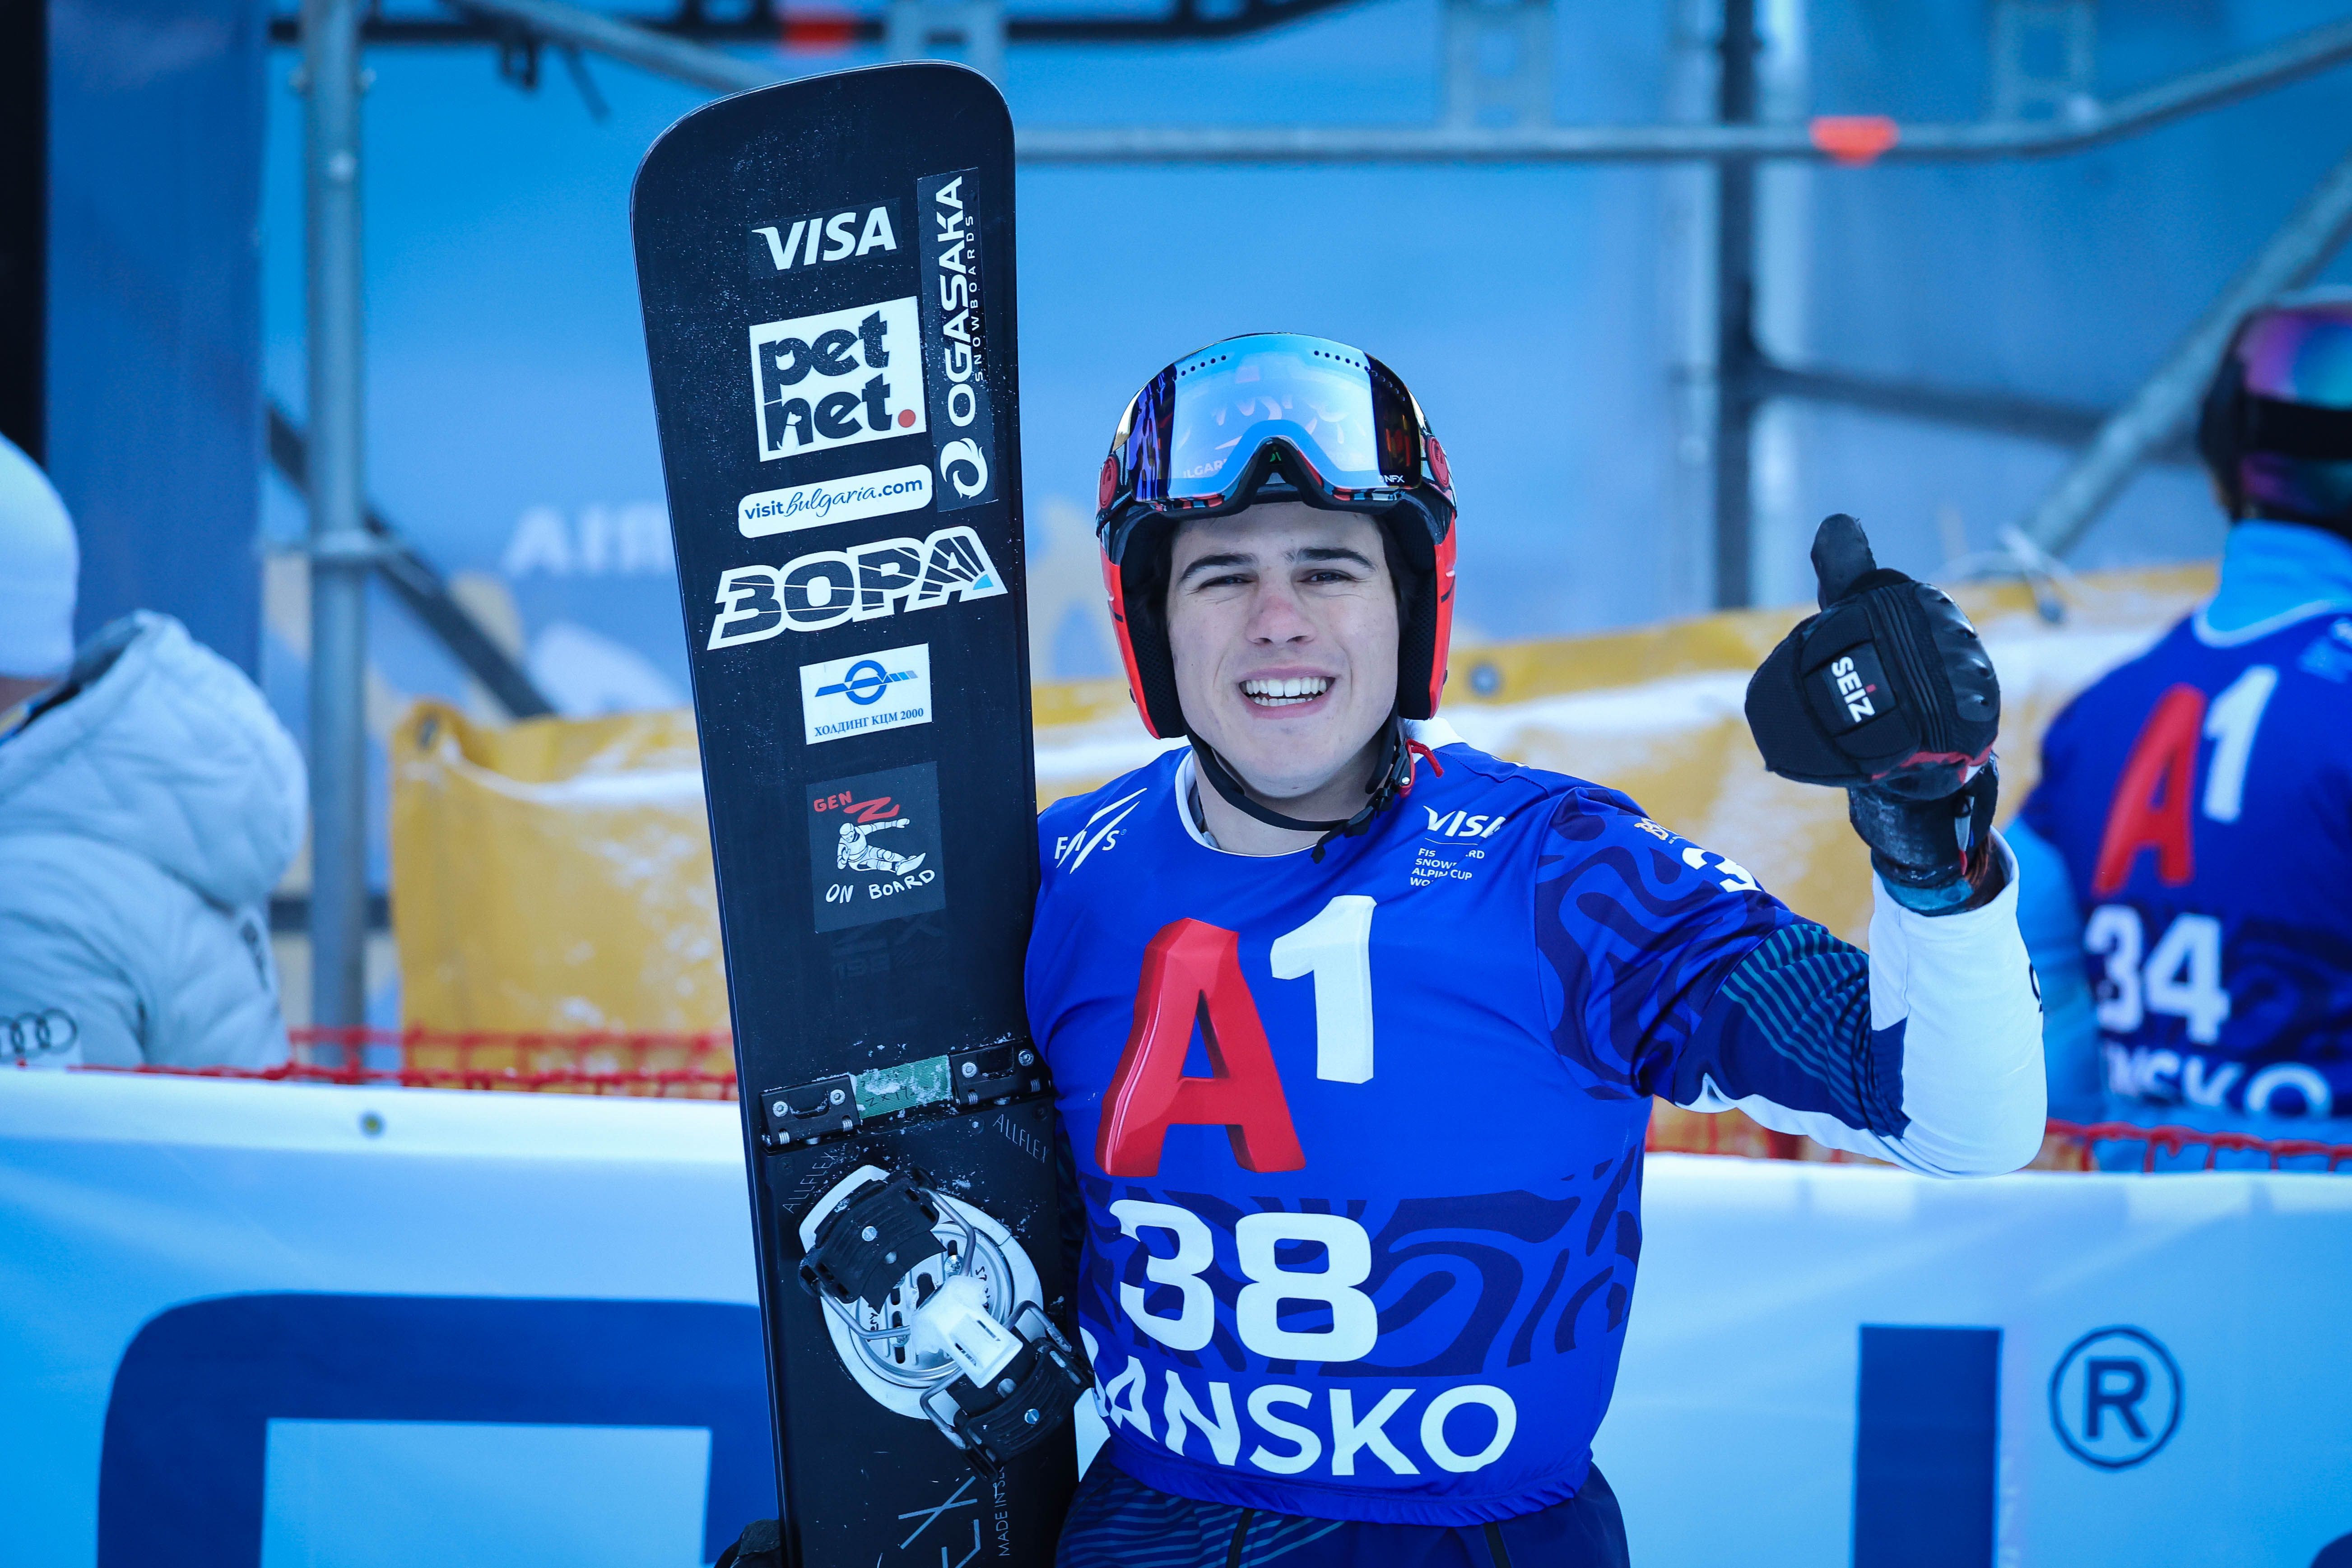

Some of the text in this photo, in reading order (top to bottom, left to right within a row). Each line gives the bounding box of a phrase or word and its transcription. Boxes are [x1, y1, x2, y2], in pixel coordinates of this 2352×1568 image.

[752, 207, 897, 270] VISA
[936, 176, 976, 427] OGASAKA
[965, 216, 983, 382] SNOWBOARDS
[759, 310, 888, 402] pet
[744, 477, 923, 520] visitbulgaria.com
[1831, 656, 1876, 723] SEIZ
[814, 708, 924, 737] ХОЛДИНГ КЦМ 2000
[814, 791, 900, 823] GEN Z
[1418, 848, 1436, 857] FIS
[1450, 869, 1473, 881] CUP
[826, 869, 935, 904] ON BOARD
[2084, 904, 2231, 1046] 34
[1095, 895, 1377, 1177] A1
[993, 1113, 1048, 1164] ALLFLEX
[782, 1152, 838, 1214] ALLFLEX
[1109, 1199, 1378, 1362] 38
[995, 1492, 1007, 1508] IN
[995, 1511, 1010, 1556] MADE
